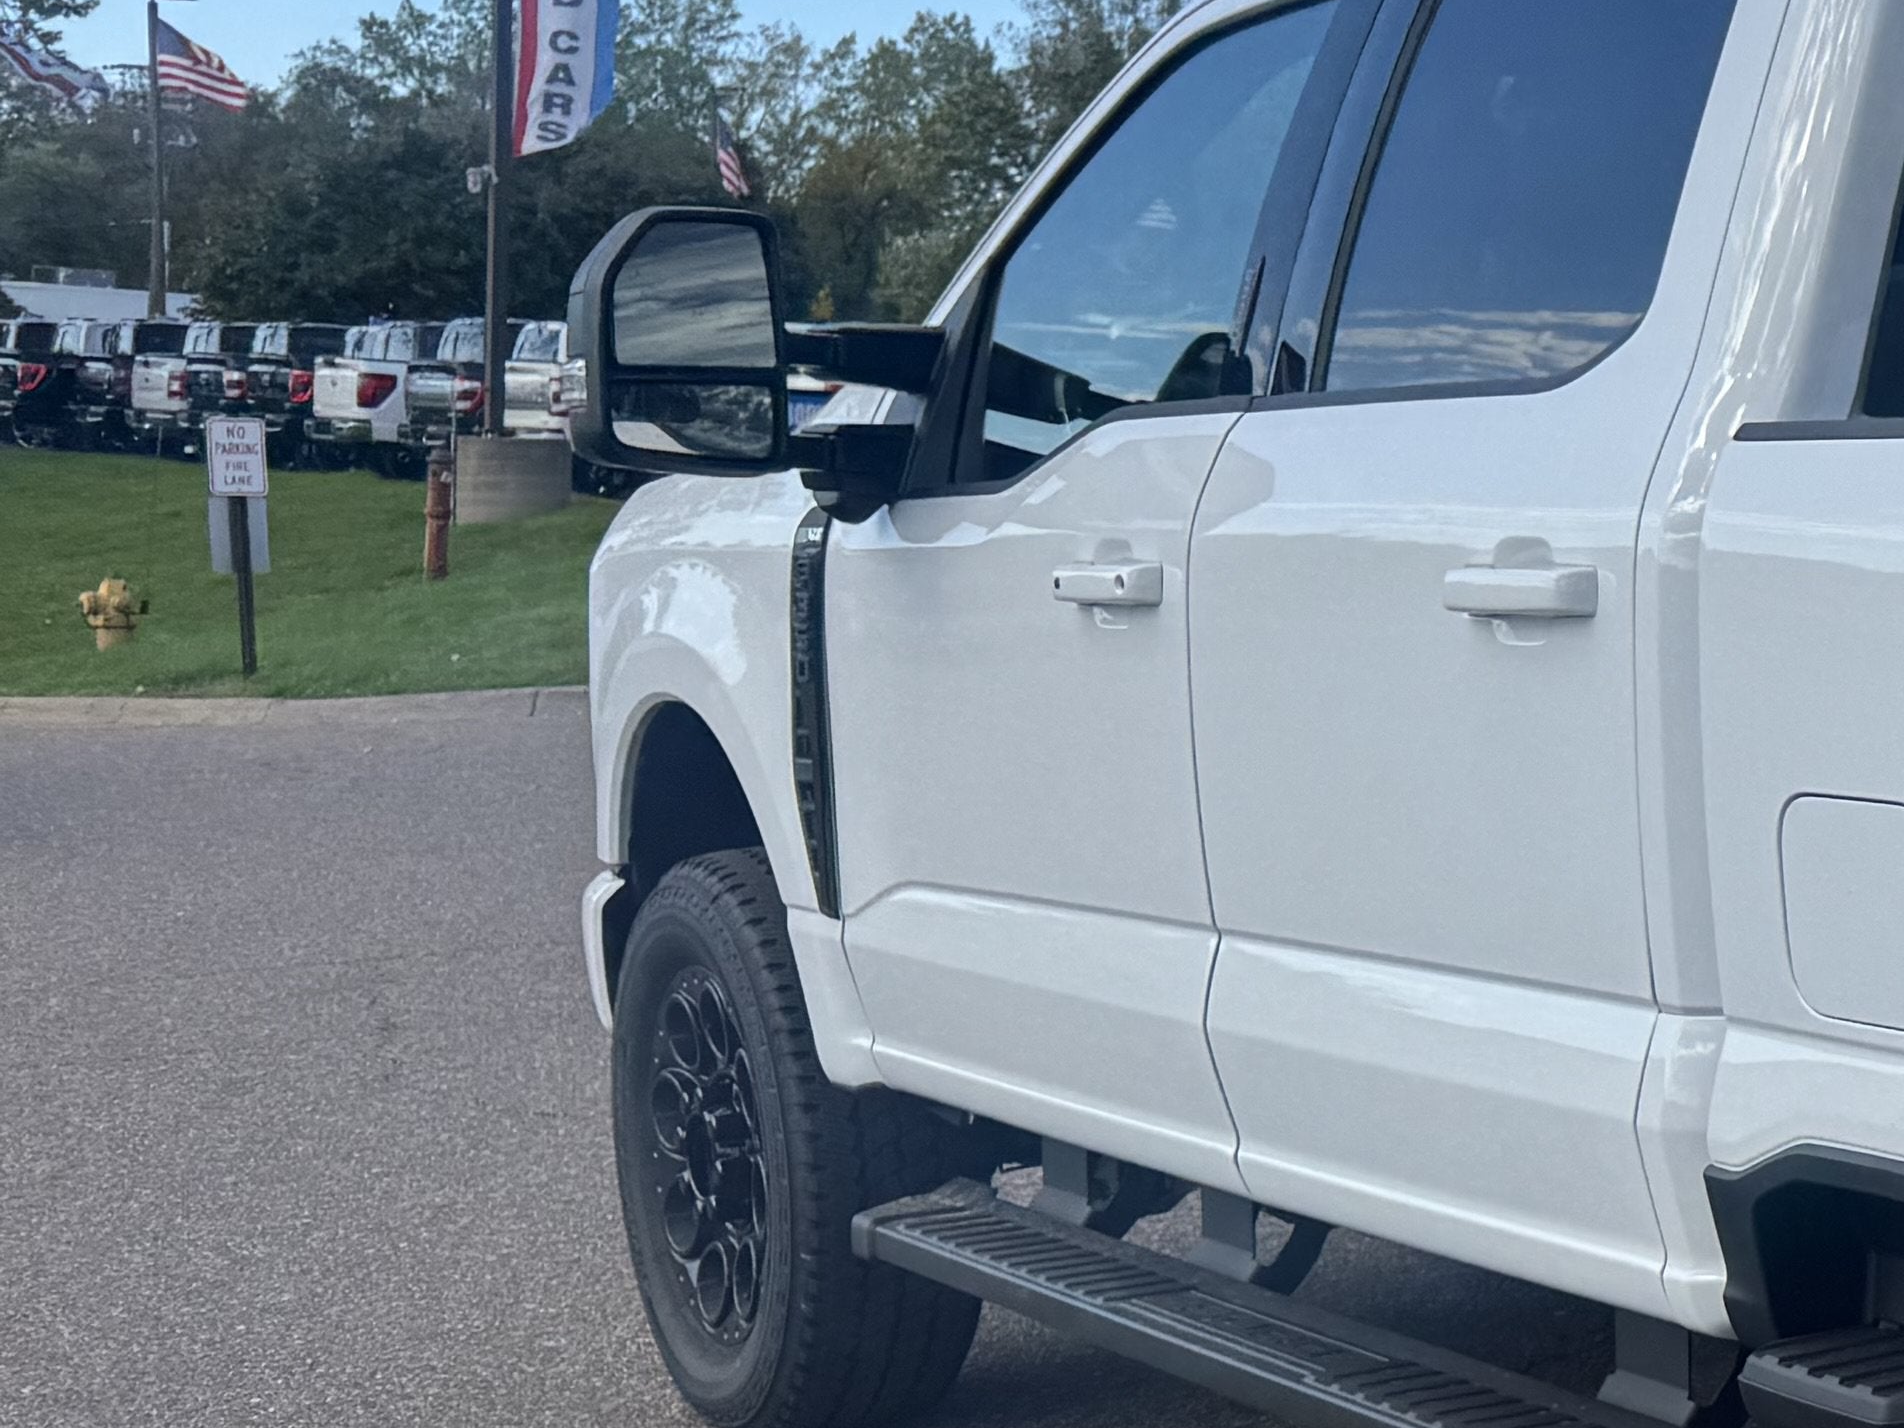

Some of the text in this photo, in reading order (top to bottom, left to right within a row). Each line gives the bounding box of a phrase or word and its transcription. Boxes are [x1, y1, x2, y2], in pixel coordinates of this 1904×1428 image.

[536, 30, 580, 143] CARS
[226, 426, 245, 439] NO
[215, 442, 259, 455] PARKING
[225, 461, 249, 472] FIRE
[224, 475, 253, 486] LANE
